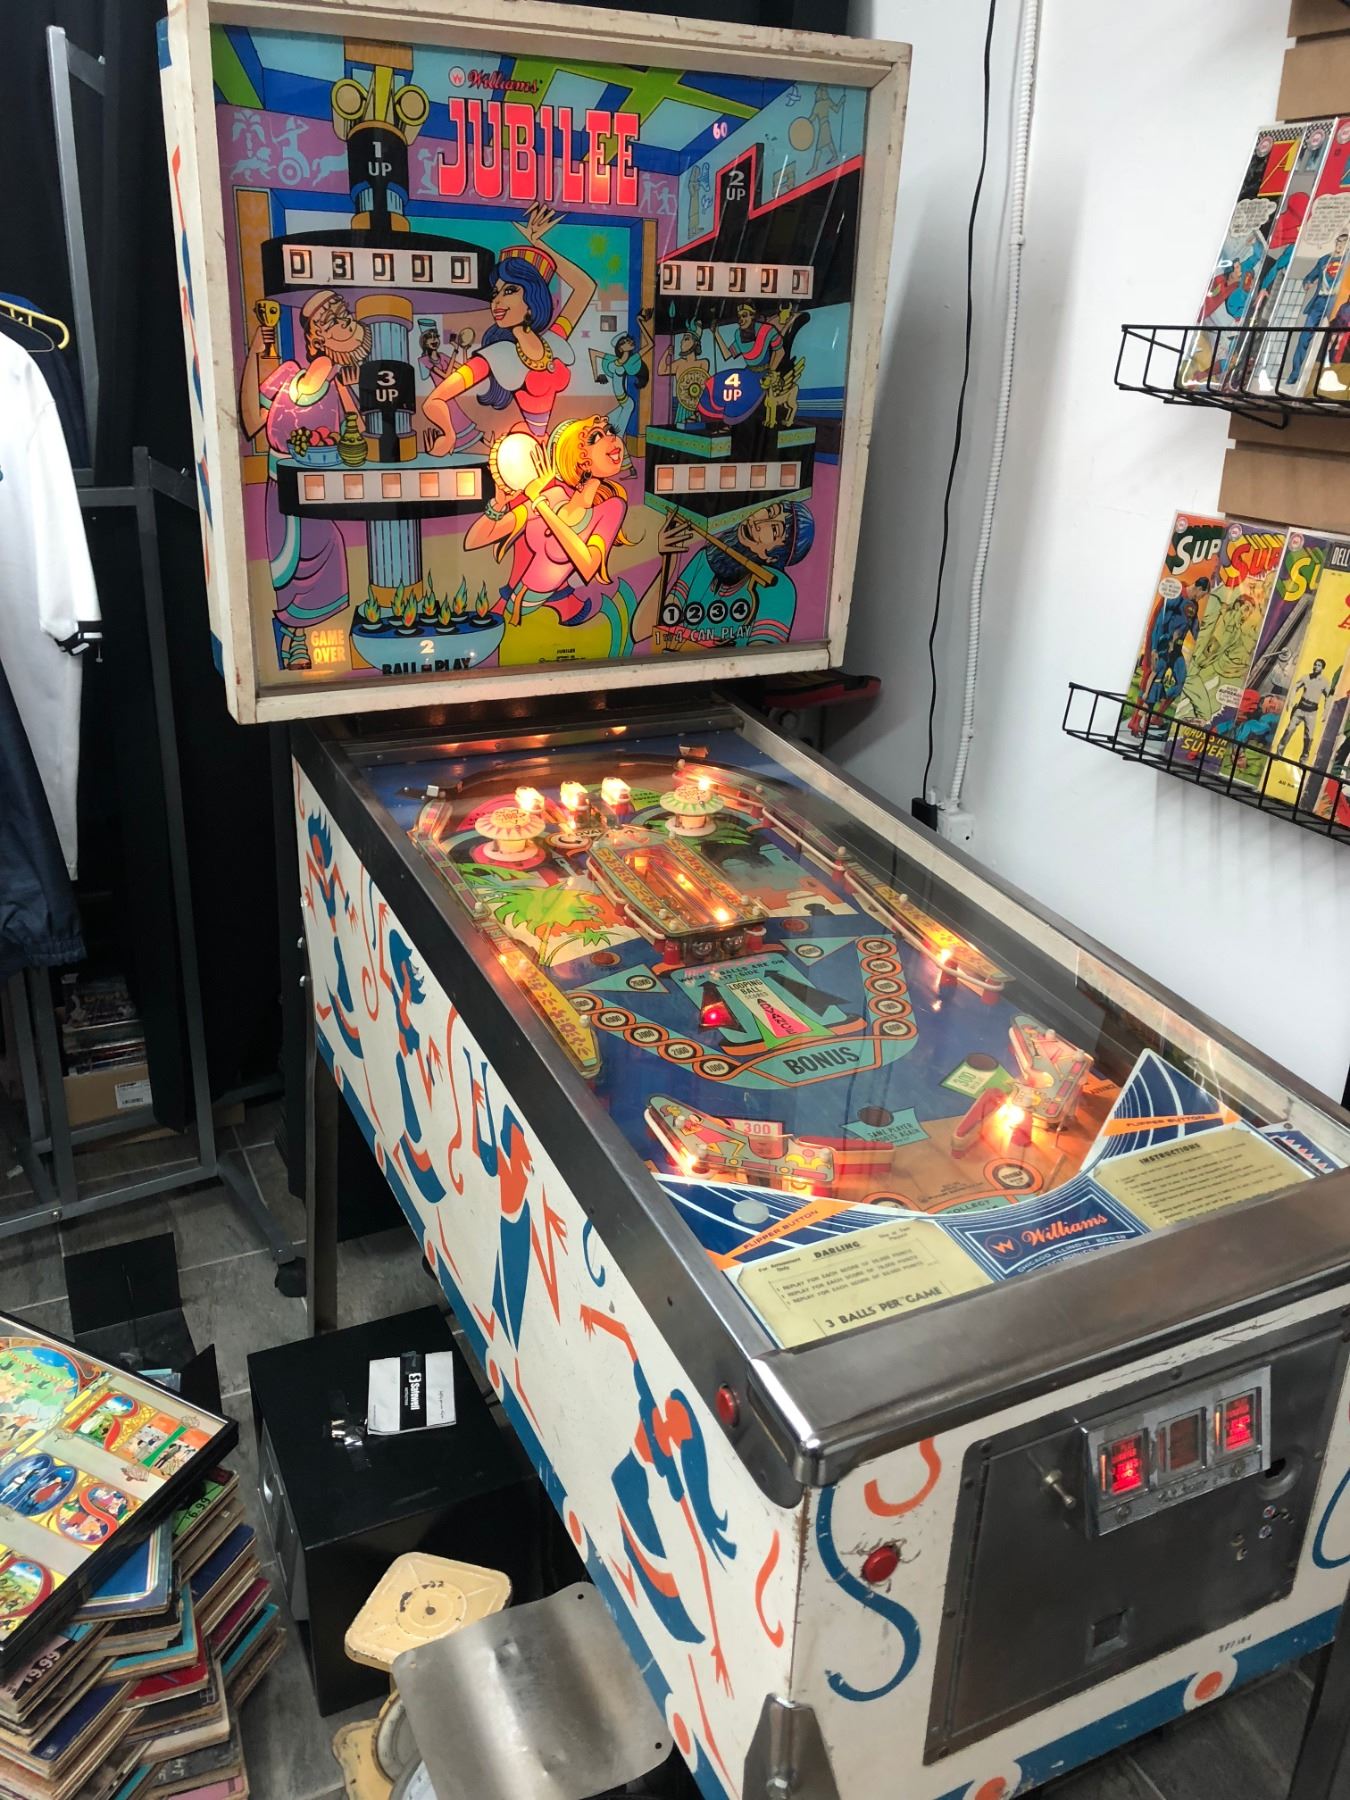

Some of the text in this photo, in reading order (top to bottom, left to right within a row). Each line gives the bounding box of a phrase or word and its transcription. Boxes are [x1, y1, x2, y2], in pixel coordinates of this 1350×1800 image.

[372, 141, 383, 158] 1
[438, 96, 640, 206] JUBILEE
[367, 162, 393, 177] UP
[728, 170, 746, 187] 2
[726, 188, 747, 202] UP
[376, 370, 397, 387] 3
[723, 373, 742, 388] 4
[375, 388, 399, 403] UP
[722, 388, 743, 402] UP
[310, 629, 345, 647] GAME
[690, 627, 715, 642] CAN
[721, 624, 752, 640] PLAY
[313, 646, 346, 665] OVER
[419, 639, 436, 655] 2
[728, 979, 763, 992] LOOPING
[739, 986, 762, 996] BALL
[783, 1046, 860, 1076] BONUS
[743, 1122, 771, 1137] 300
[1138, 1142, 1201, 1165] INSTRUCTIONS
[743, 1209, 819, 1250] FLIPPER BUTTON
[1021, 1213, 1109, 1247] Williams
[813, 1240, 861, 1259] DARLING
[825, 1285, 943, 1329] 3 BALLS PER GAME
